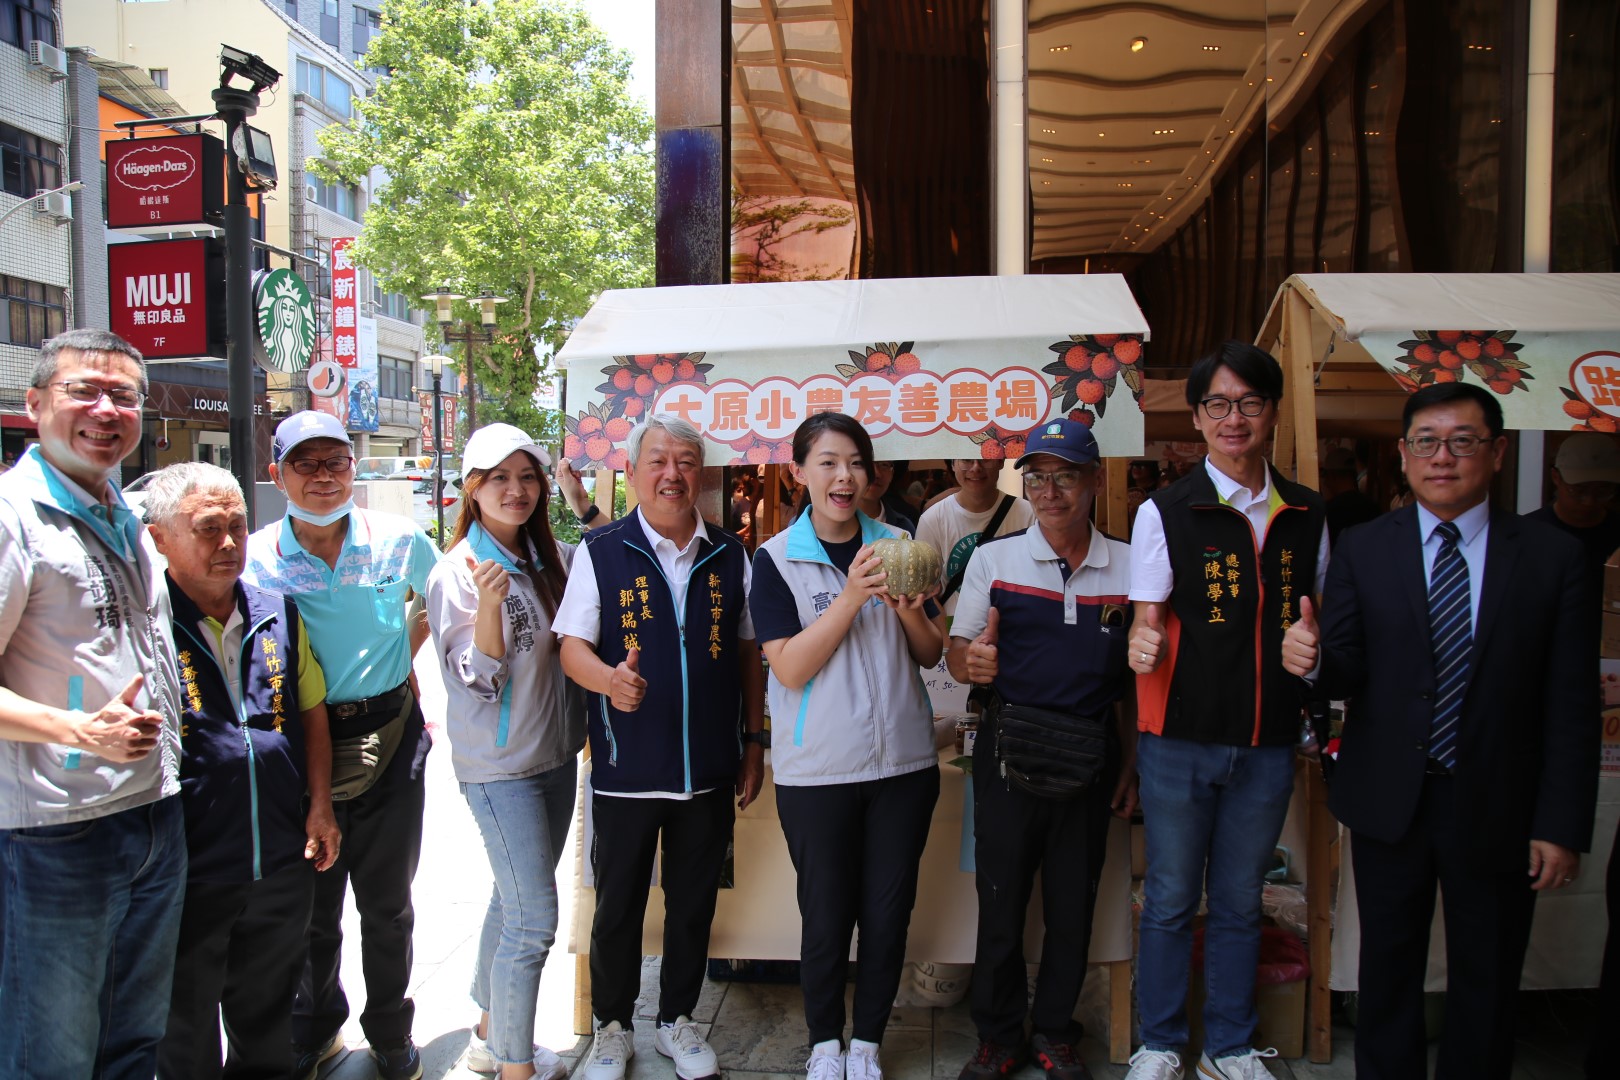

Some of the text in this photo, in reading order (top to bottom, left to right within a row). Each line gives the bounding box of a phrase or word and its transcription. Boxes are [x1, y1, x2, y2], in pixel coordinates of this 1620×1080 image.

[123, 160, 187, 176] Häagen-Dazs
[150, 210, 161, 219] B1
[126, 272, 191, 307] MUJI
[133, 308, 186, 325] 無印良品
[153, 337, 166, 347] 7F
[194, 398, 229, 413] LOUISA
[952, 534, 979, 559] TIMBE
[1204, 560, 1226, 623] 陳學立
[1225, 553, 1240, 598] 總幹事
[635, 575, 654, 620] 理事長
[812, 591, 832, 613] 高
[503, 594, 535, 654] 施淑婷
[619, 589, 642, 652] 郭瑞誠
[708, 572, 723, 660] 新竹市農會
[261, 637, 287, 733] 新竹市農會
